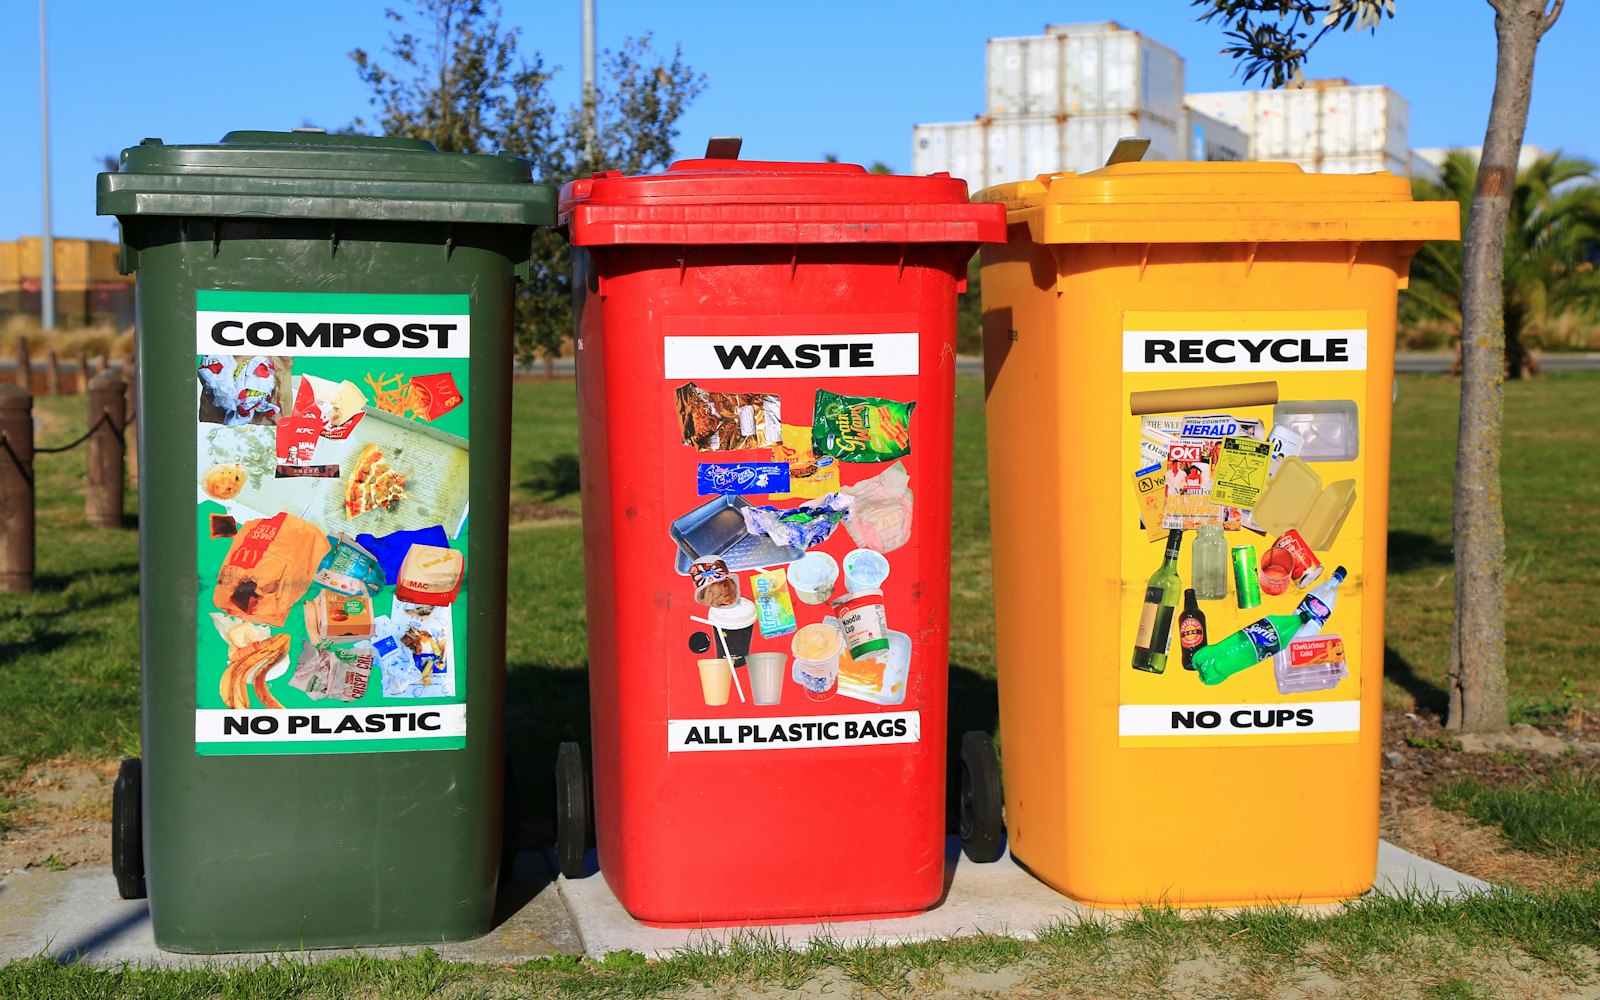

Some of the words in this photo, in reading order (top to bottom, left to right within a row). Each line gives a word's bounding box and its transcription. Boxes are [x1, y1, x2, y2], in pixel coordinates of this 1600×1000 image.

[211, 320, 458, 349] COMPOST
[713, 343, 874, 370] WASTE
[1144, 338, 1349, 364] RECYCLE
[295, 427, 315, 435] KFC
[835, 413, 866, 451] Grain
[1147, 420, 1162, 429] THE
[1164, 421, 1182, 429] WEE
[1182, 423, 1237, 436] HERALD
[1170, 446, 1200, 461] OK!
[409, 580, 429, 590] MAC
[756, 577, 770, 594] up
[757, 596, 776, 629] fresh
[842, 613, 861, 626] Noodle
[844, 625, 855, 634] Cup
[1244, 623, 1278, 642] Sprite
[1300, 650, 1314, 658] Gold
[351, 672, 368, 699] CRISPY
[223, 715, 279, 735] NO
[288, 711, 441, 735] PLASTIC
[1171, 710, 1222, 729] NO
[1229, 708, 1314, 729] CUPS
[684, 725, 733, 745] ALL
[738, 721, 840, 744] PLASTIC
[844, 718, 907, 740] BAGS
